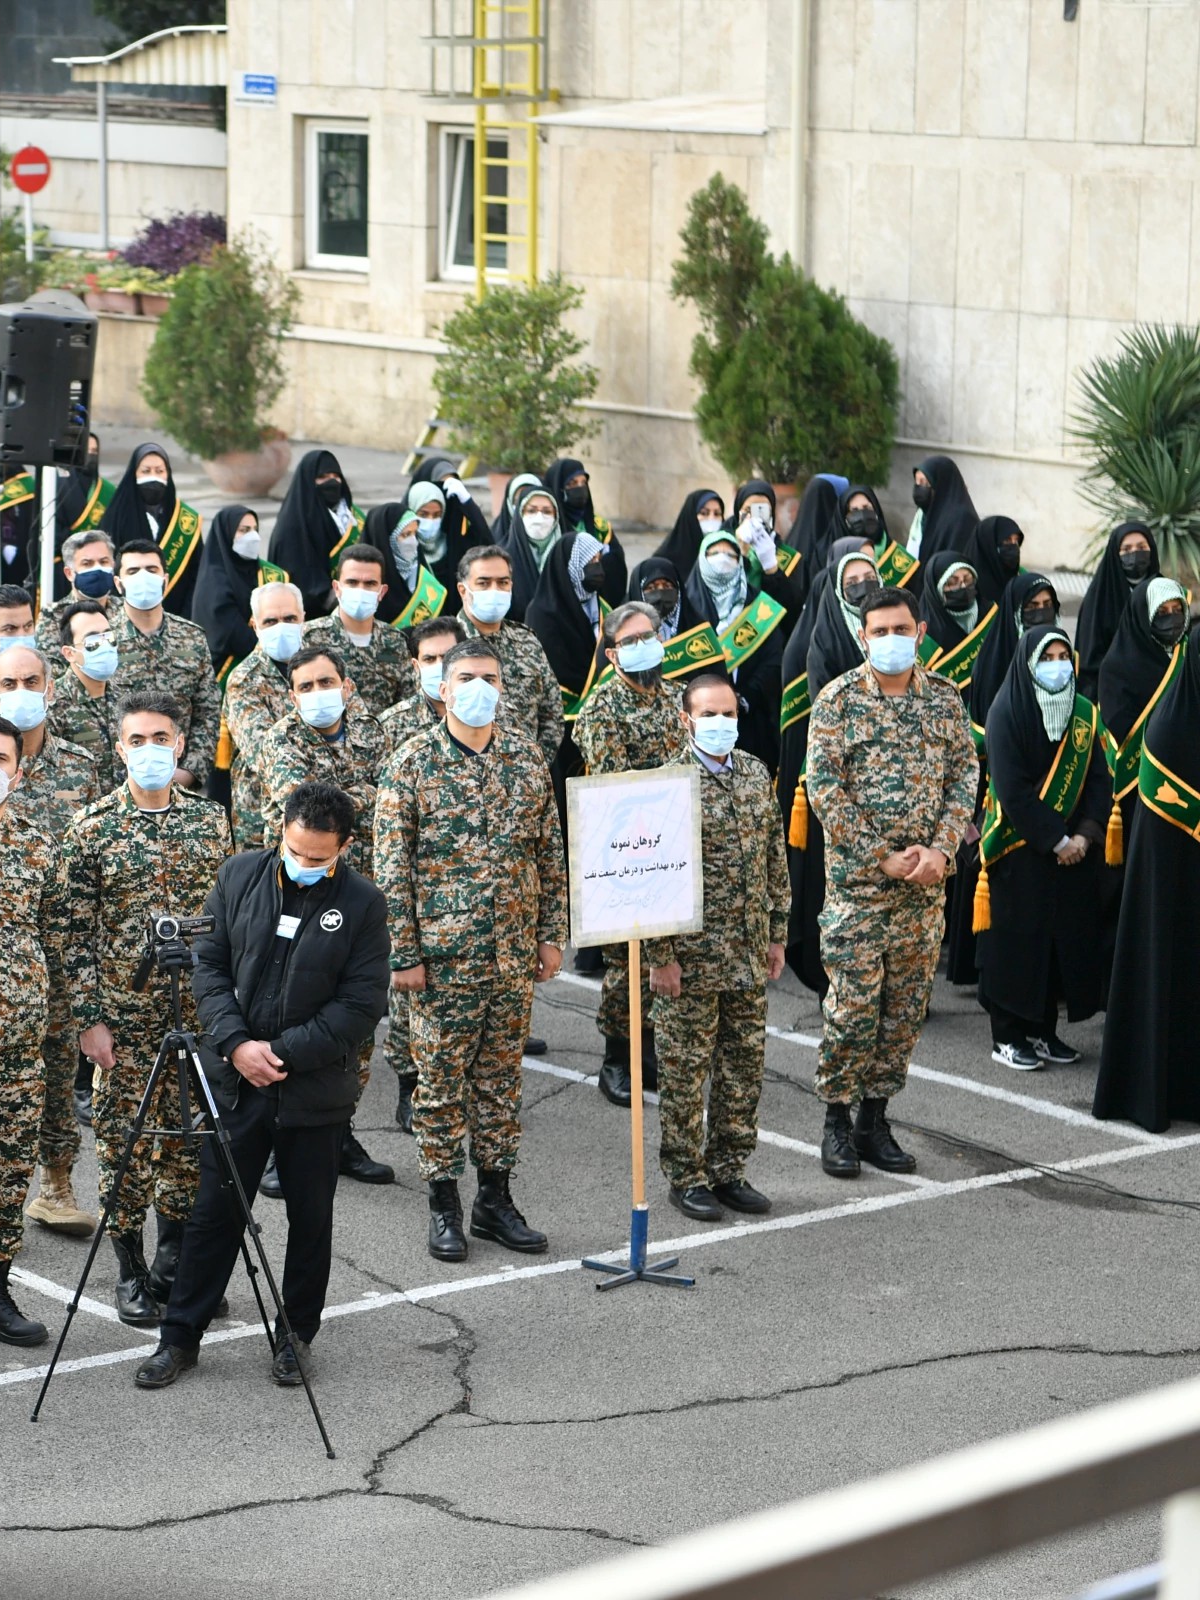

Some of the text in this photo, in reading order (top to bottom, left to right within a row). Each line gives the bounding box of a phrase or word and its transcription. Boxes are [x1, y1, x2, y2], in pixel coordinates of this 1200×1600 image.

[610, 833, 661, 852] گروهان نمونه
[644, 862, 669, 872] بهداشت
[670, 861, 688, 871] حوزه
[584, 870, 597, 880] نفت
[598, 870, 617, 878] صنعت
[618, 866, 638, 878] درمان
